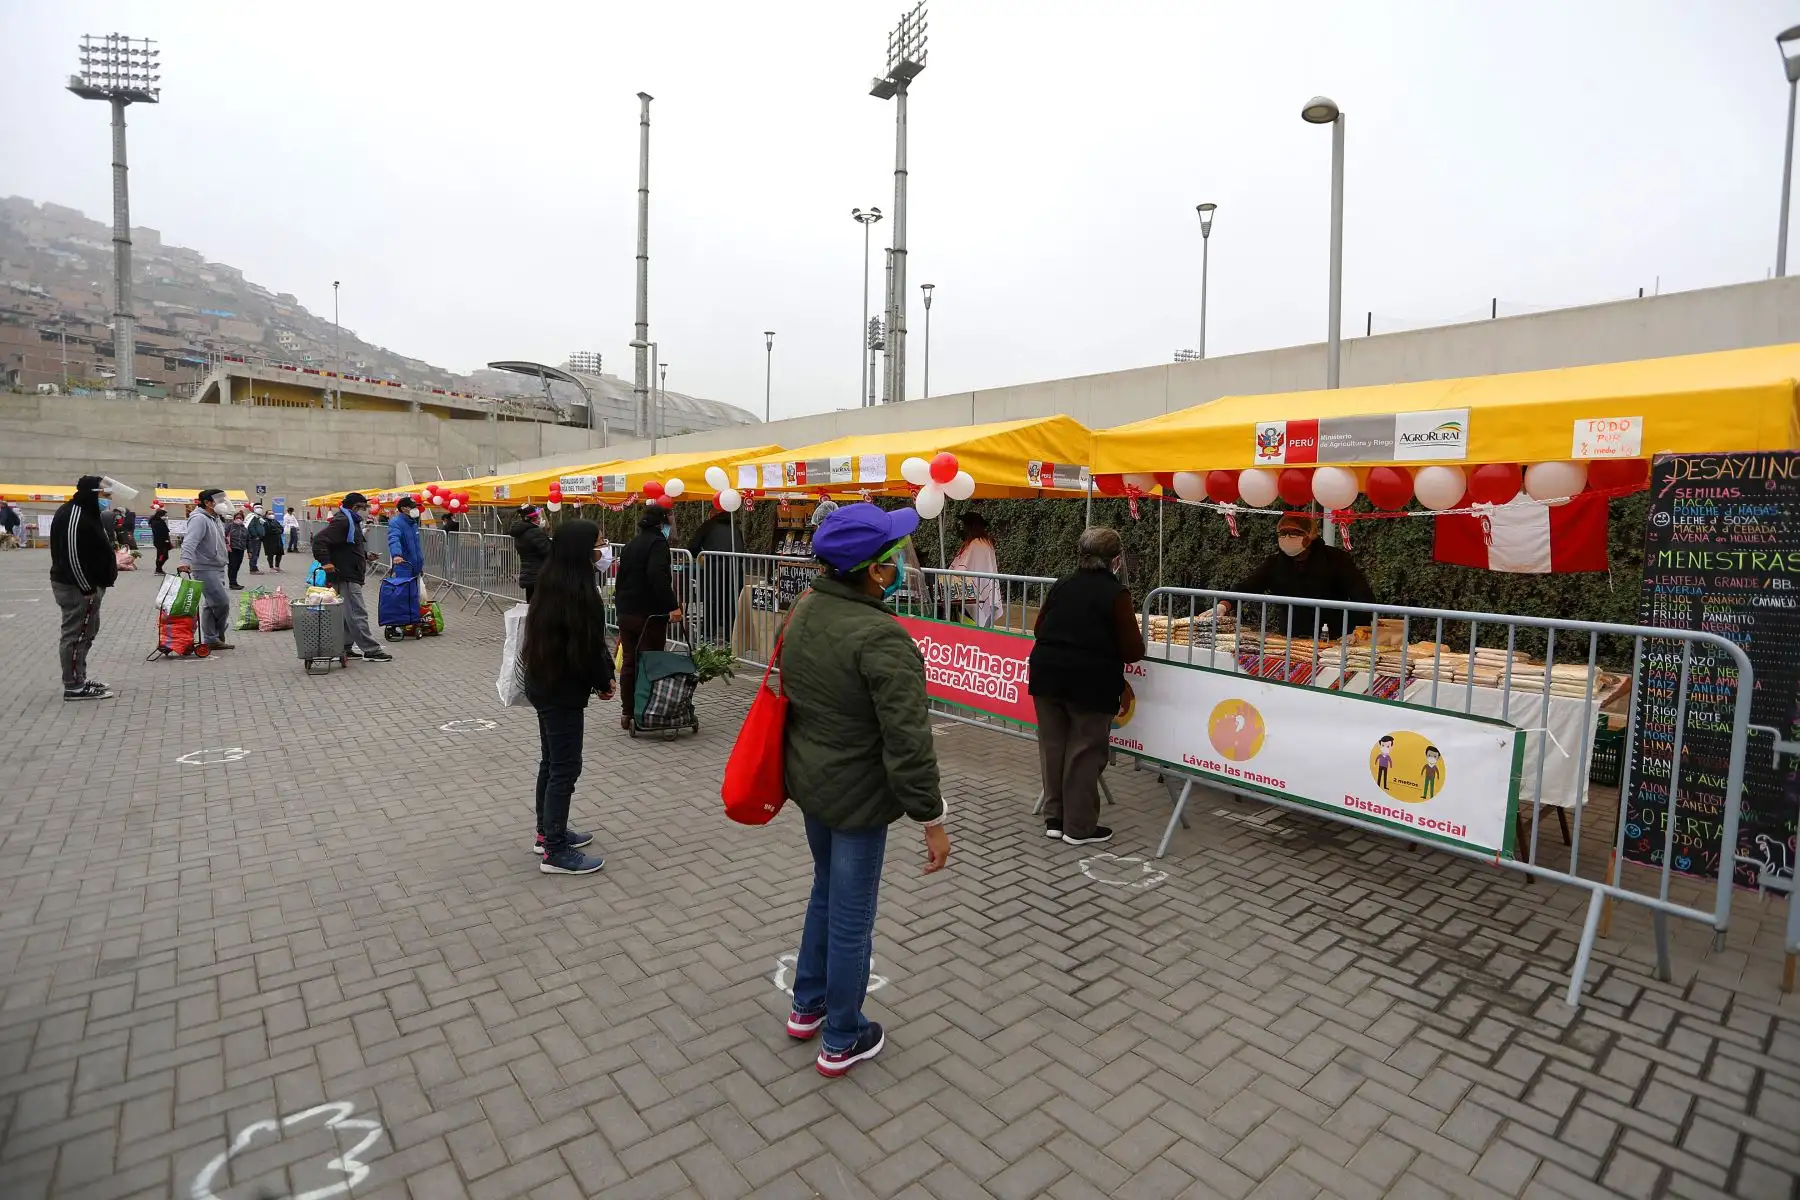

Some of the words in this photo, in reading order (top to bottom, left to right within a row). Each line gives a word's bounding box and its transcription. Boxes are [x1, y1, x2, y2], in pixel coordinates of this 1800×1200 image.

[1587, 420, 1631, 433] TODO
[1289, 436, 1314, 448] PERÚ
[1320, 433, 1352, 441] Ministerio
[1329, 440, 1366, 449] Agricultura
[1373, 438, 1394, 447] Riego
[1675, 487, 1741, 499] SEMILLAS
[1673, 498, 1714, 507] MACA
[1673, 506, 1719, 516] PONCHE
[1738, 506, 1778, 516] HABAS
[1672, 515, 1706, 525] LECHE
[1723, 515, 1759, 525] SOYA
[1673, 525, 1717, 534] MACHKA
[1734, 524, 1777, 534] CEBADA
[1671, 533, 1710, 542] AVENA
[1730, 534, 1777, 543] HOJUELA
[1657, 550, 1800, 572] MENESTRAS
[1655, 576, 1706, 587] LENTEJA
[1714, 577, 1759, 588] GRANDE
[1654, 586, 1703, 595] ALVERJA
[1654, 594, 1692, 604] FRIJOL
[1653, 602, 1692, 612] FRIJOL
[1704, 605, 1732, 614] ROJO
[1653, 610, 1692, 621] FRIJOL
[1702, 612, 1755, 625] PANAMITO
[1652, 619, 1692, 630] FRIJOL
[1701, 622, 1740, 633] NEGRO
[910, 636, 952, 665] dos
[1648, 653, 1715, 667] GARBNZO
[1125, 663, 1147, 677] DA:
[1648, 670, 1677, 682] PAPA
[1649, 661, 1678, 673] PAPA
[1717, 666, 1740, 679] NEG
[1648, 679, 1676, 689] MAIZ
[1687, 683, 1731, 696] ANCHA
[1648, 688, 1674, 699] MAIZ
[1687, 691, 1728, 704] HULLPI
[1644, 704, 1677, 717] TRIGO
[1688, 710, 1721, 723] MOTE
[1645, 713, 1677, 725] TRIGO
[1646, 721, 1674, 734] MOTE
[1108, 735, 1144, 751] scarilla
[1643, 739, 1689, 755] LINAA
[1643, 756, 1671, 770] MAN
[1183, 753, 1221, 771] Lávate
[1224, 764, 1241, 777] las
[1243, 771, 1286, 788] manos
[1398, 779, 1418, 787] metros
[1642, 764, 1671, 779] CREM
[1697, 773, 1749, 794] ALVEA
[1344, 795, 1414, 823] Distancia
[1418, 817, 1466, 837] social
